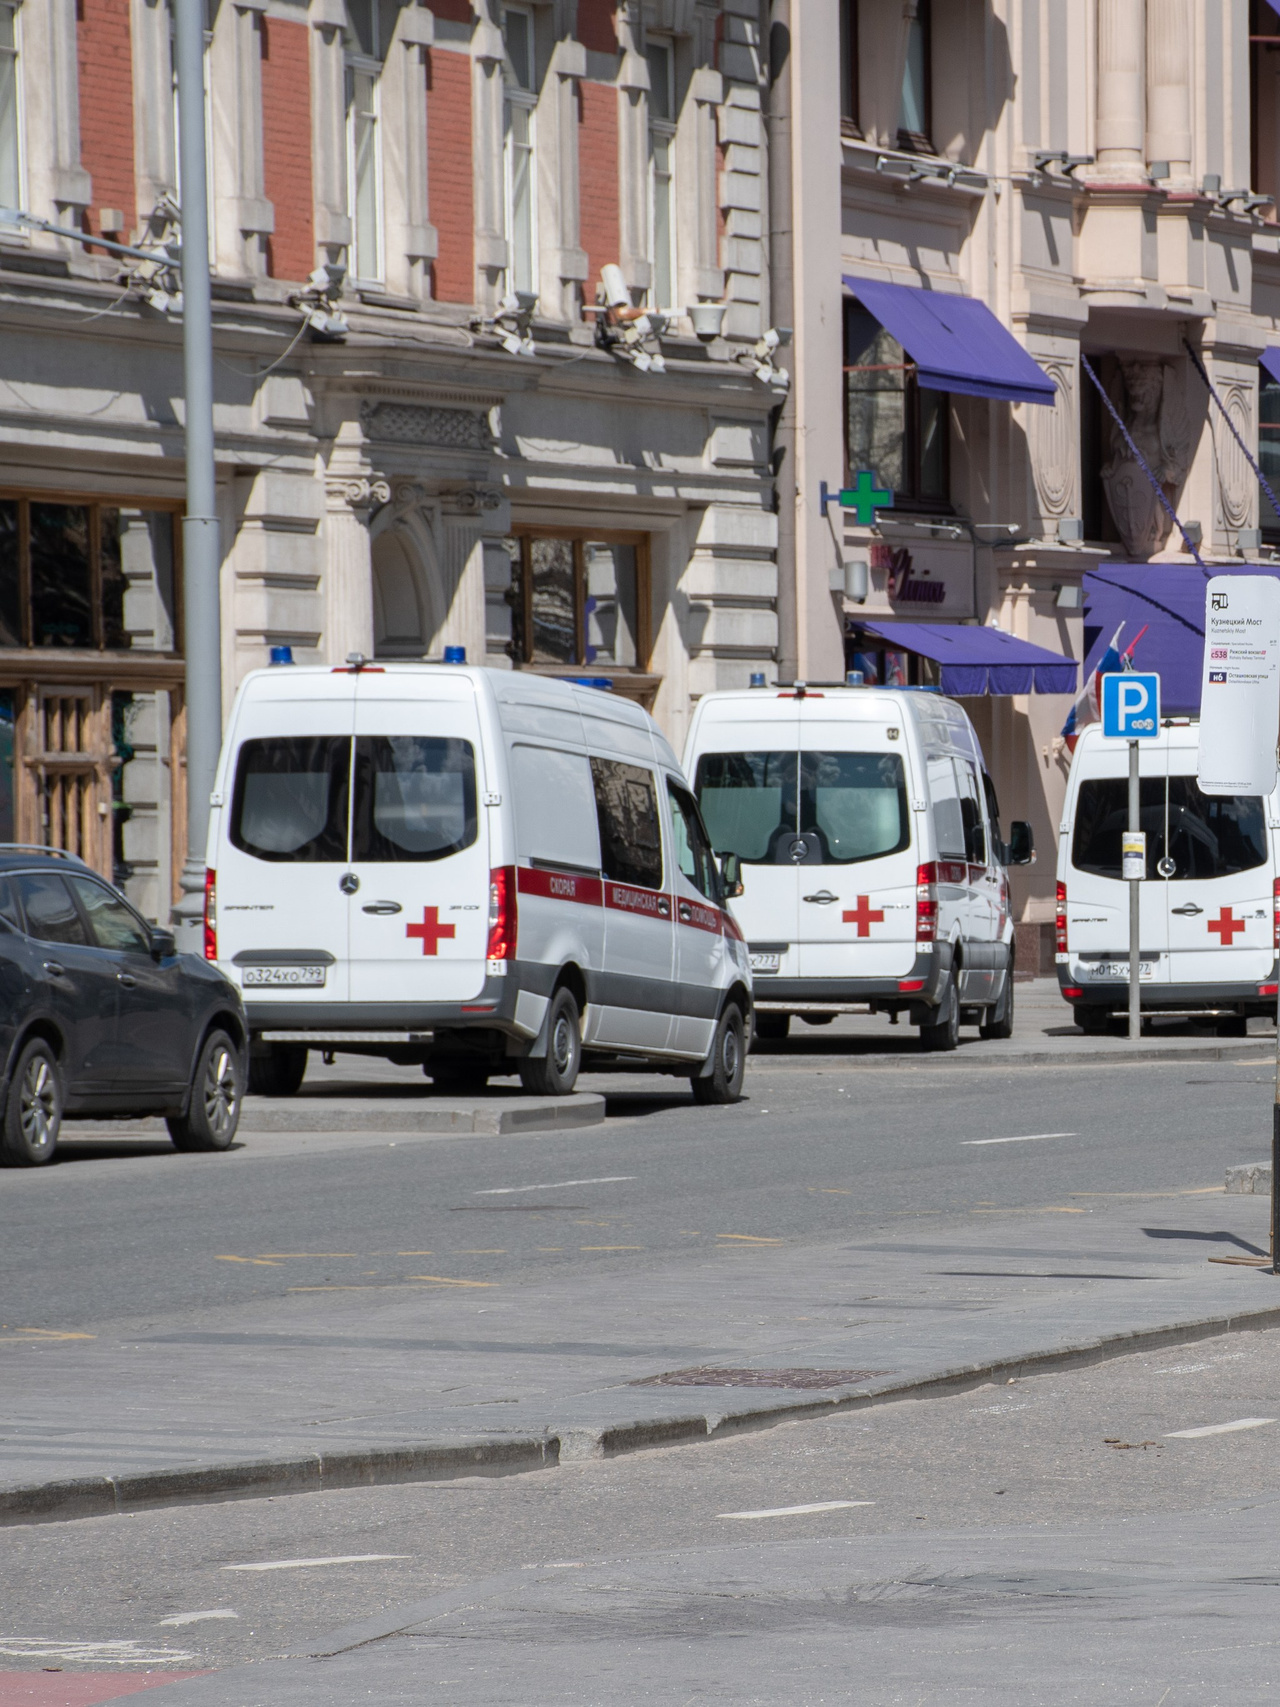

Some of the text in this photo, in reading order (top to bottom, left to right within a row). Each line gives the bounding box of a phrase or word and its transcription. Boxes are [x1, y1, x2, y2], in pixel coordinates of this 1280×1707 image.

[1210, 618, 1245, 626] Кузнецкий
[1118, 681, 1148, 731] P
[550, 877, 716, 929] СКОРАЯ МЕДИЦИНСКАЯ ПОМОЩЬ
[758, 954, 776, 964] 777
[301, 968, 322, 978] 799
